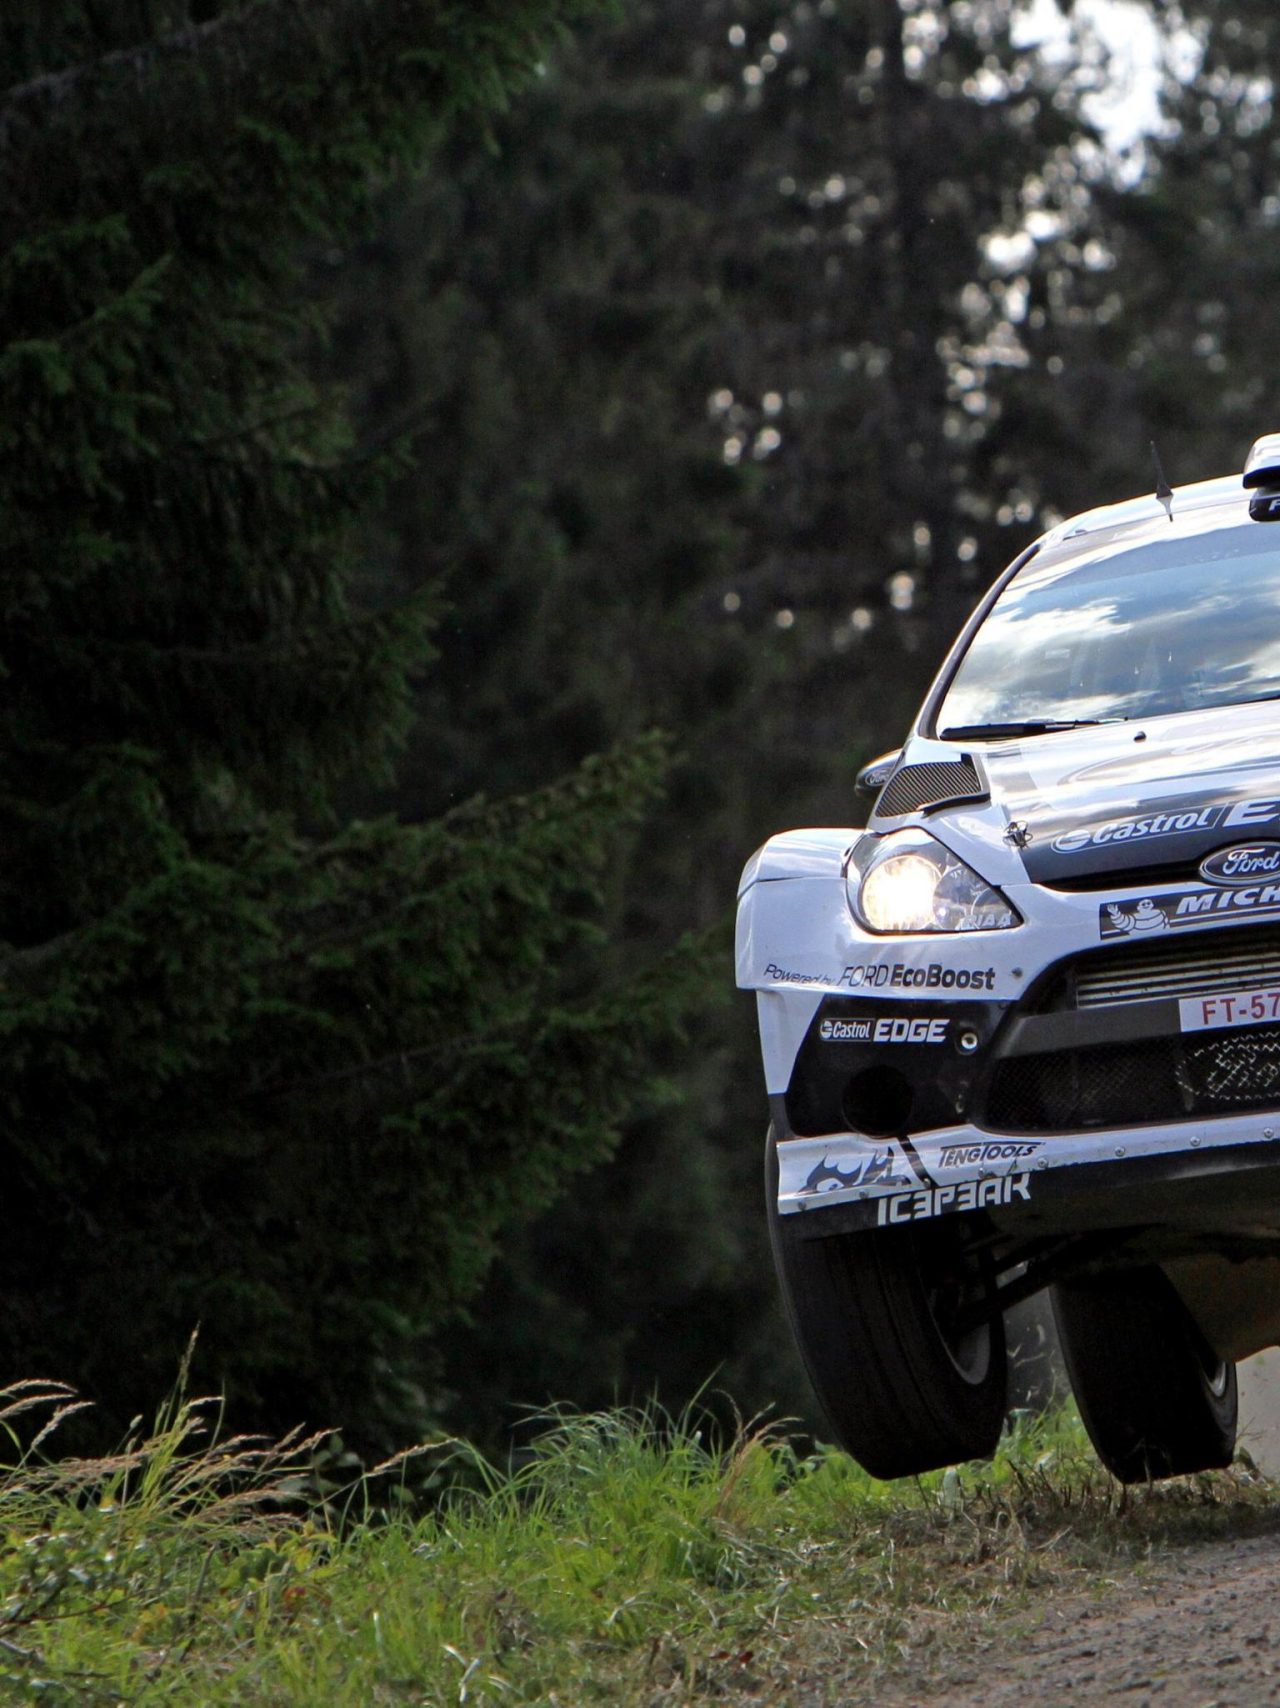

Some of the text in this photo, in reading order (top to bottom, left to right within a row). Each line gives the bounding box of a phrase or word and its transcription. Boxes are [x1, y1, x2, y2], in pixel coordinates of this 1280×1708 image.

[1092, 806, 1209, 845] Castrol
[1222, 846, 1280, 875] Ford
[763, 963, 822, 985] Powered
[836, 964, 890, 987] FORD
[890, 963, 996, 990] EcoBoost
[832, 1018, 950, 1042] Castrol EDGE
